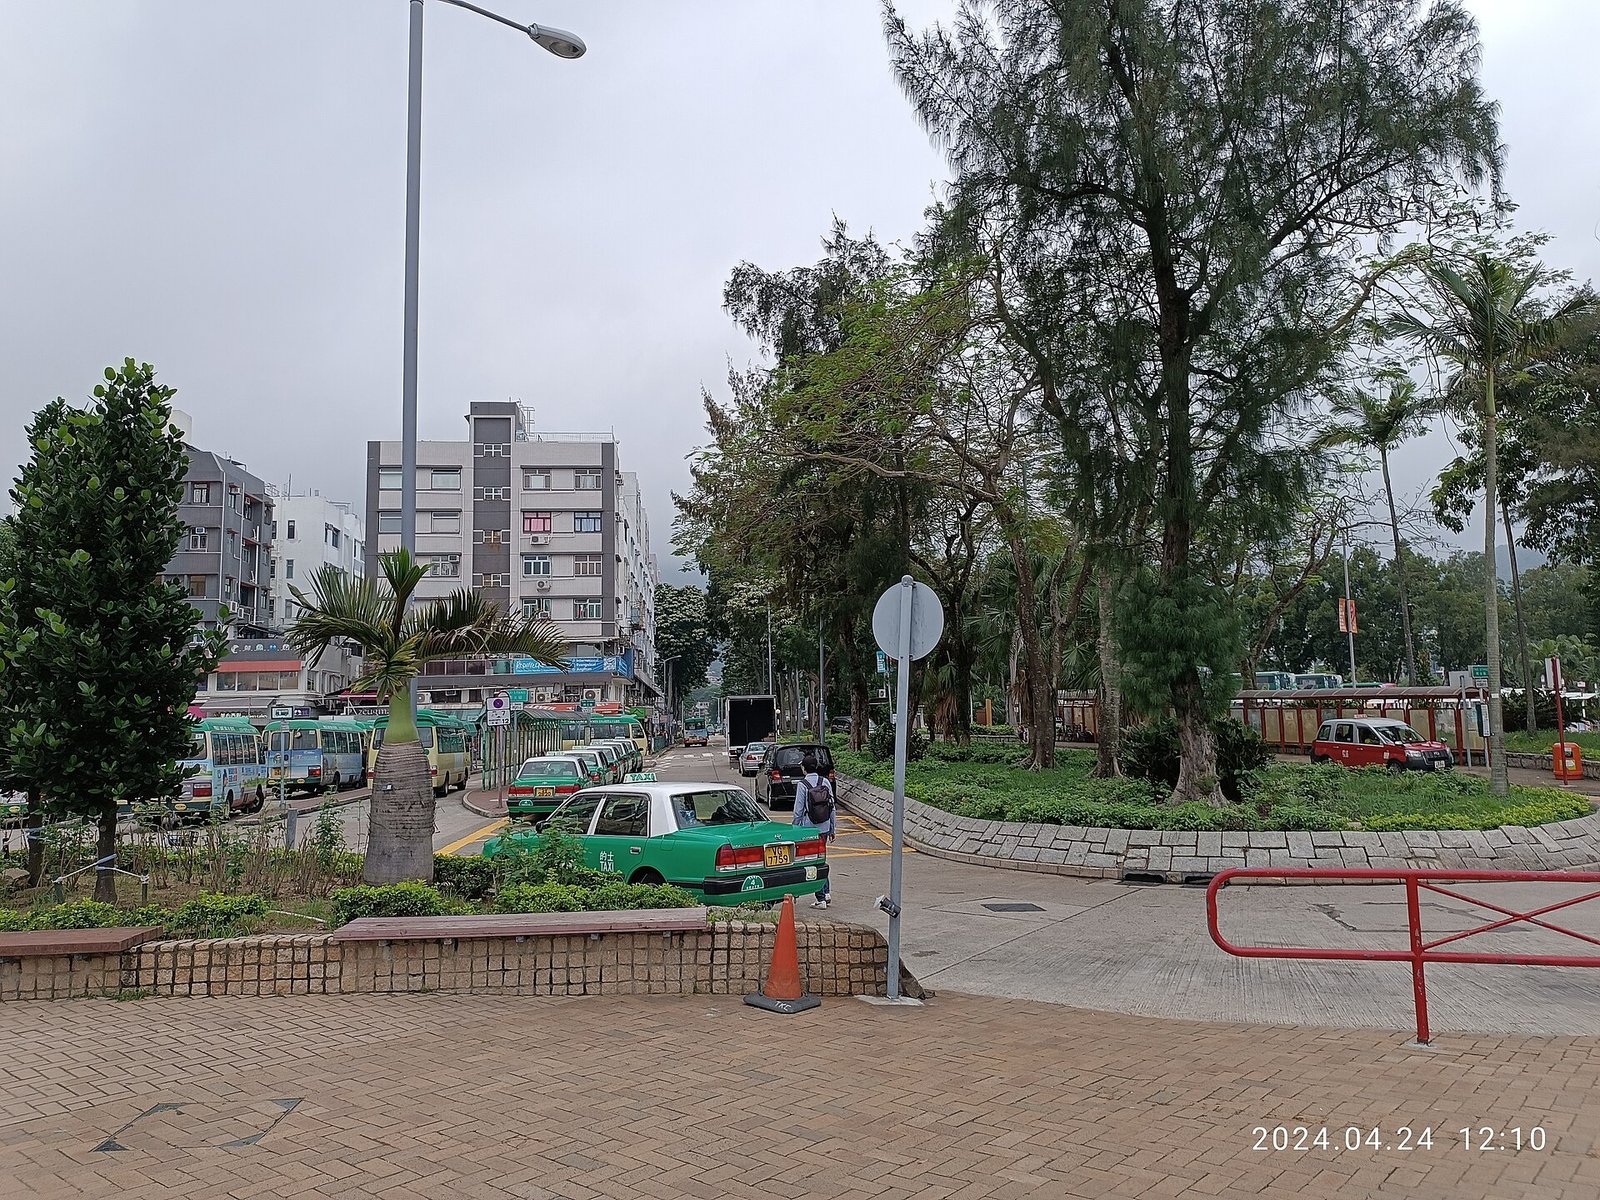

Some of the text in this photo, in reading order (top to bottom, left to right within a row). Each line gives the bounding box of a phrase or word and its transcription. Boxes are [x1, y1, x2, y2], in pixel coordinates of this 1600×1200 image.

[630, 773, 655, 782] TAXI
[599, 850, 615, 861] 的士
[772, 846, 784, 856] VG
[767, 855, 788, 866] 7759
[599, 861, 615, 872] TAXI
